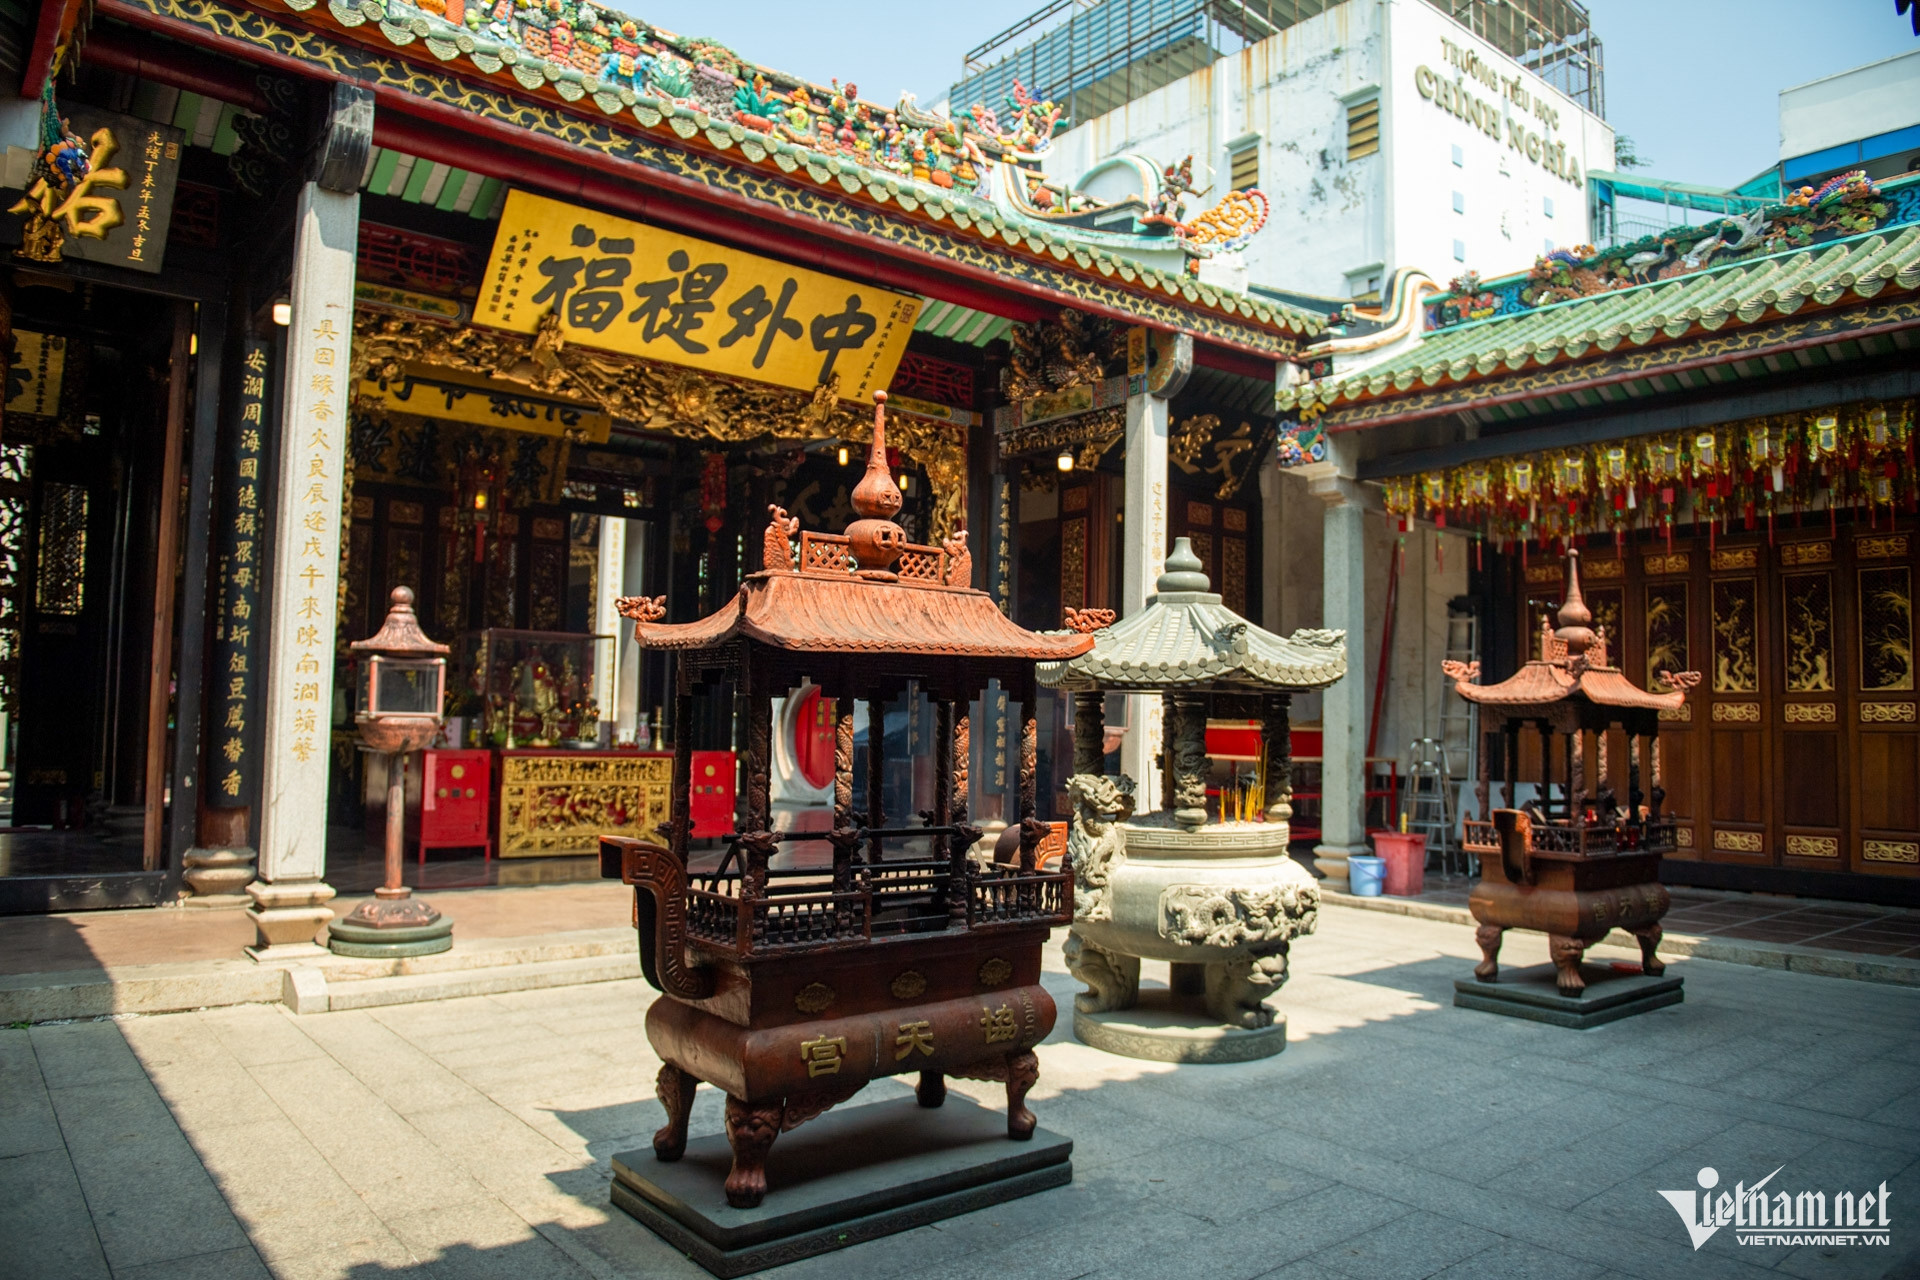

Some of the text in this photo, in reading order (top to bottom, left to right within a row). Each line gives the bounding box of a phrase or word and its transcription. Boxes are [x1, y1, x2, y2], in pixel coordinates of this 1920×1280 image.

[1415, 65, 1583, 188] CHÍNH NGHĨA
[1440, 35, 1559, 131] TRƯỜNG TIỂU HỌC
